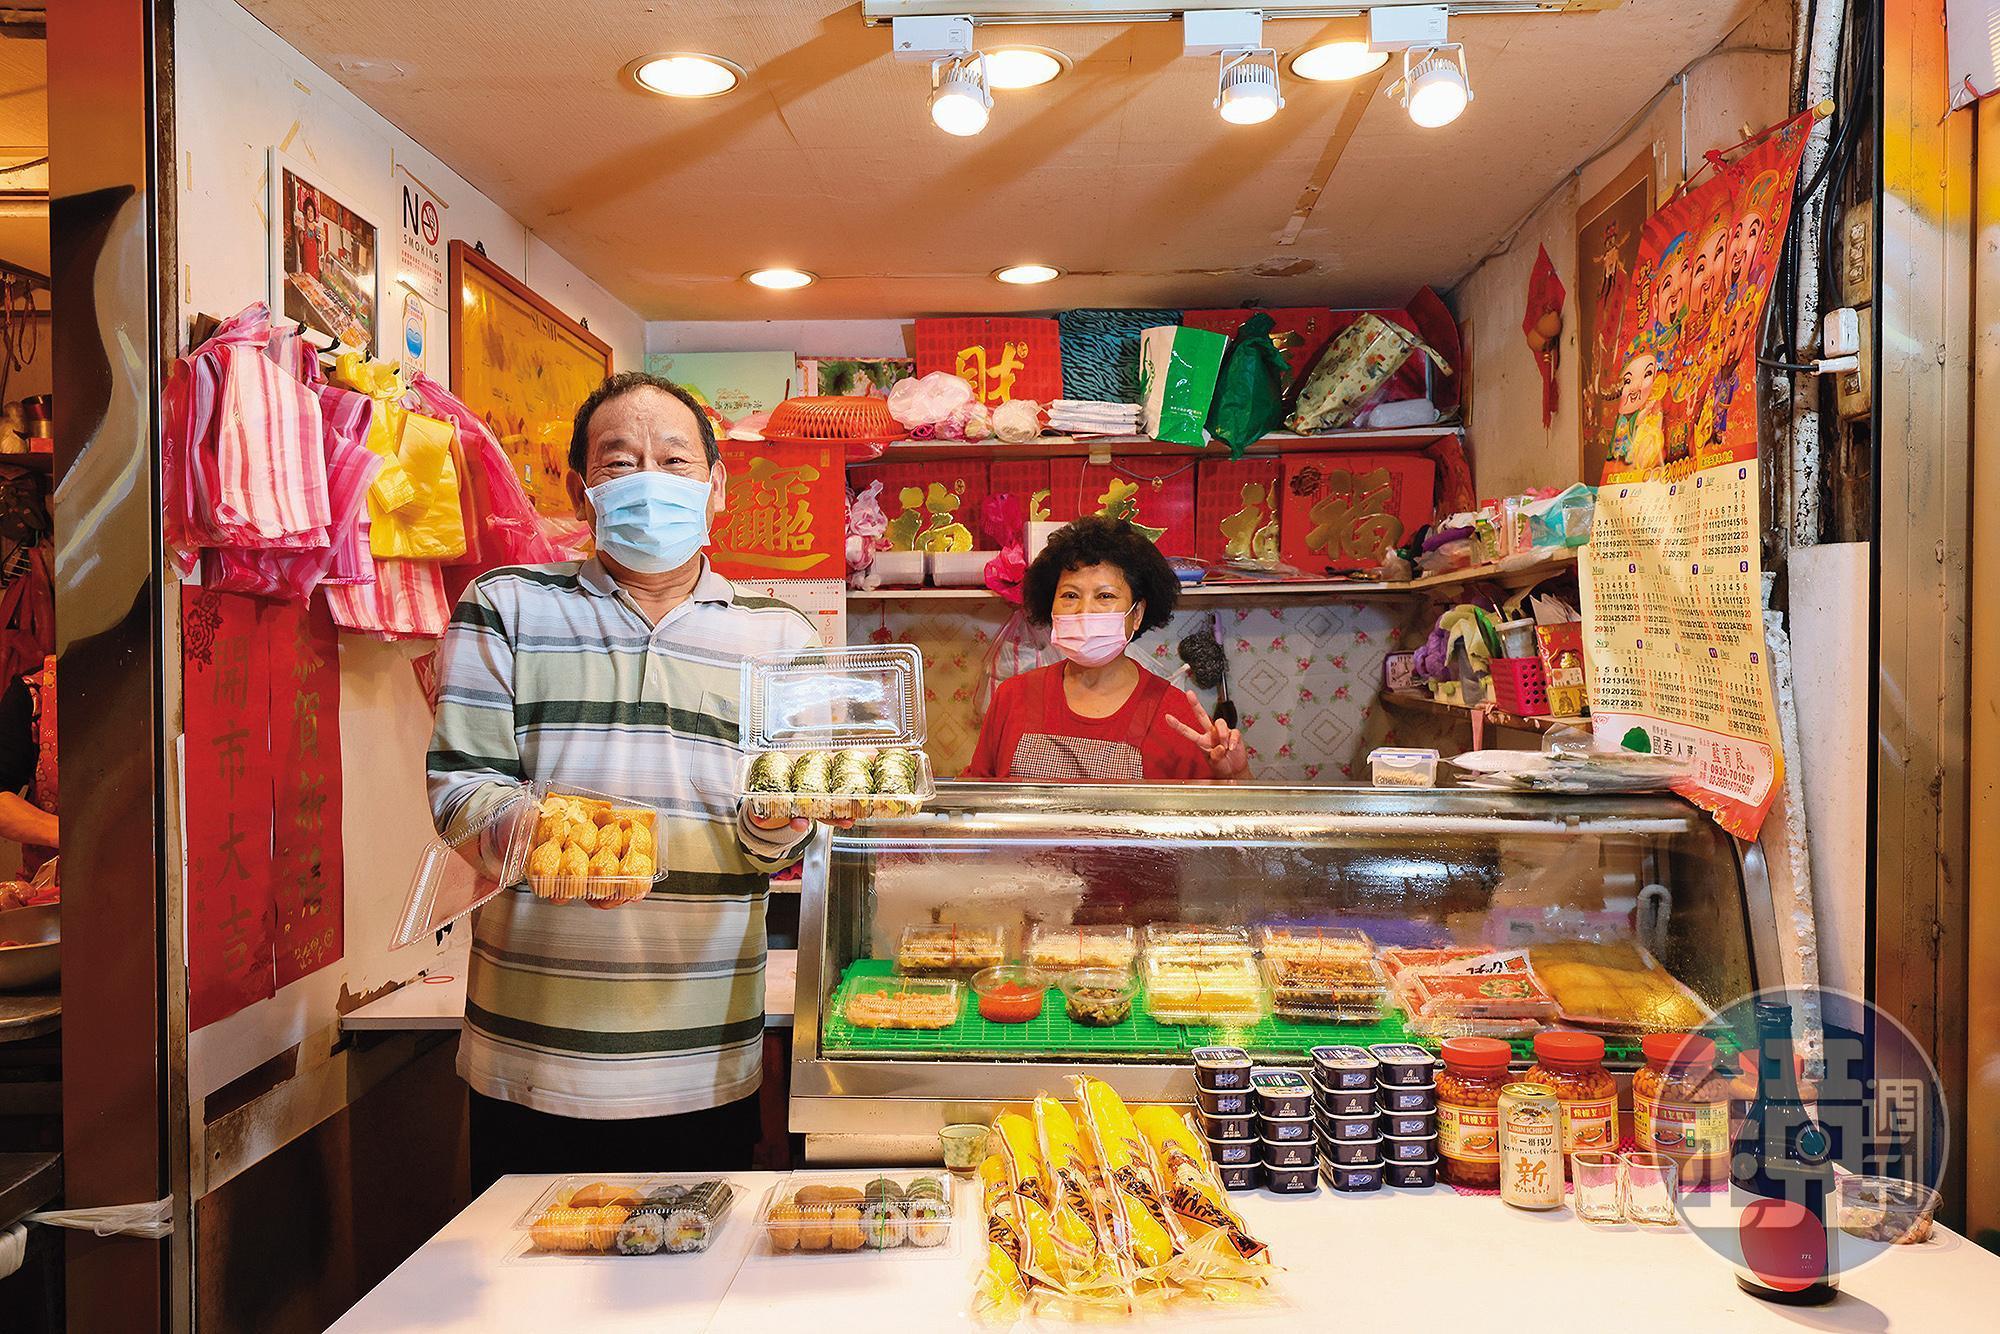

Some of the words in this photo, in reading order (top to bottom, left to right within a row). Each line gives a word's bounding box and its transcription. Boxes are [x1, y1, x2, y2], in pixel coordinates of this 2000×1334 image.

[403, 233, 439, 264] SMOKING
[883, 482, 974, 552] 福
[1305, 467, 1404, 561] 福
[211, 635, 252, 974] 開市大吉
[1509, 1125, 1526, 1133] KIRIN
[1527, 1126, 1552, 1134] ICHIBAN
[1515, 1157, 1548, 1187] 新
